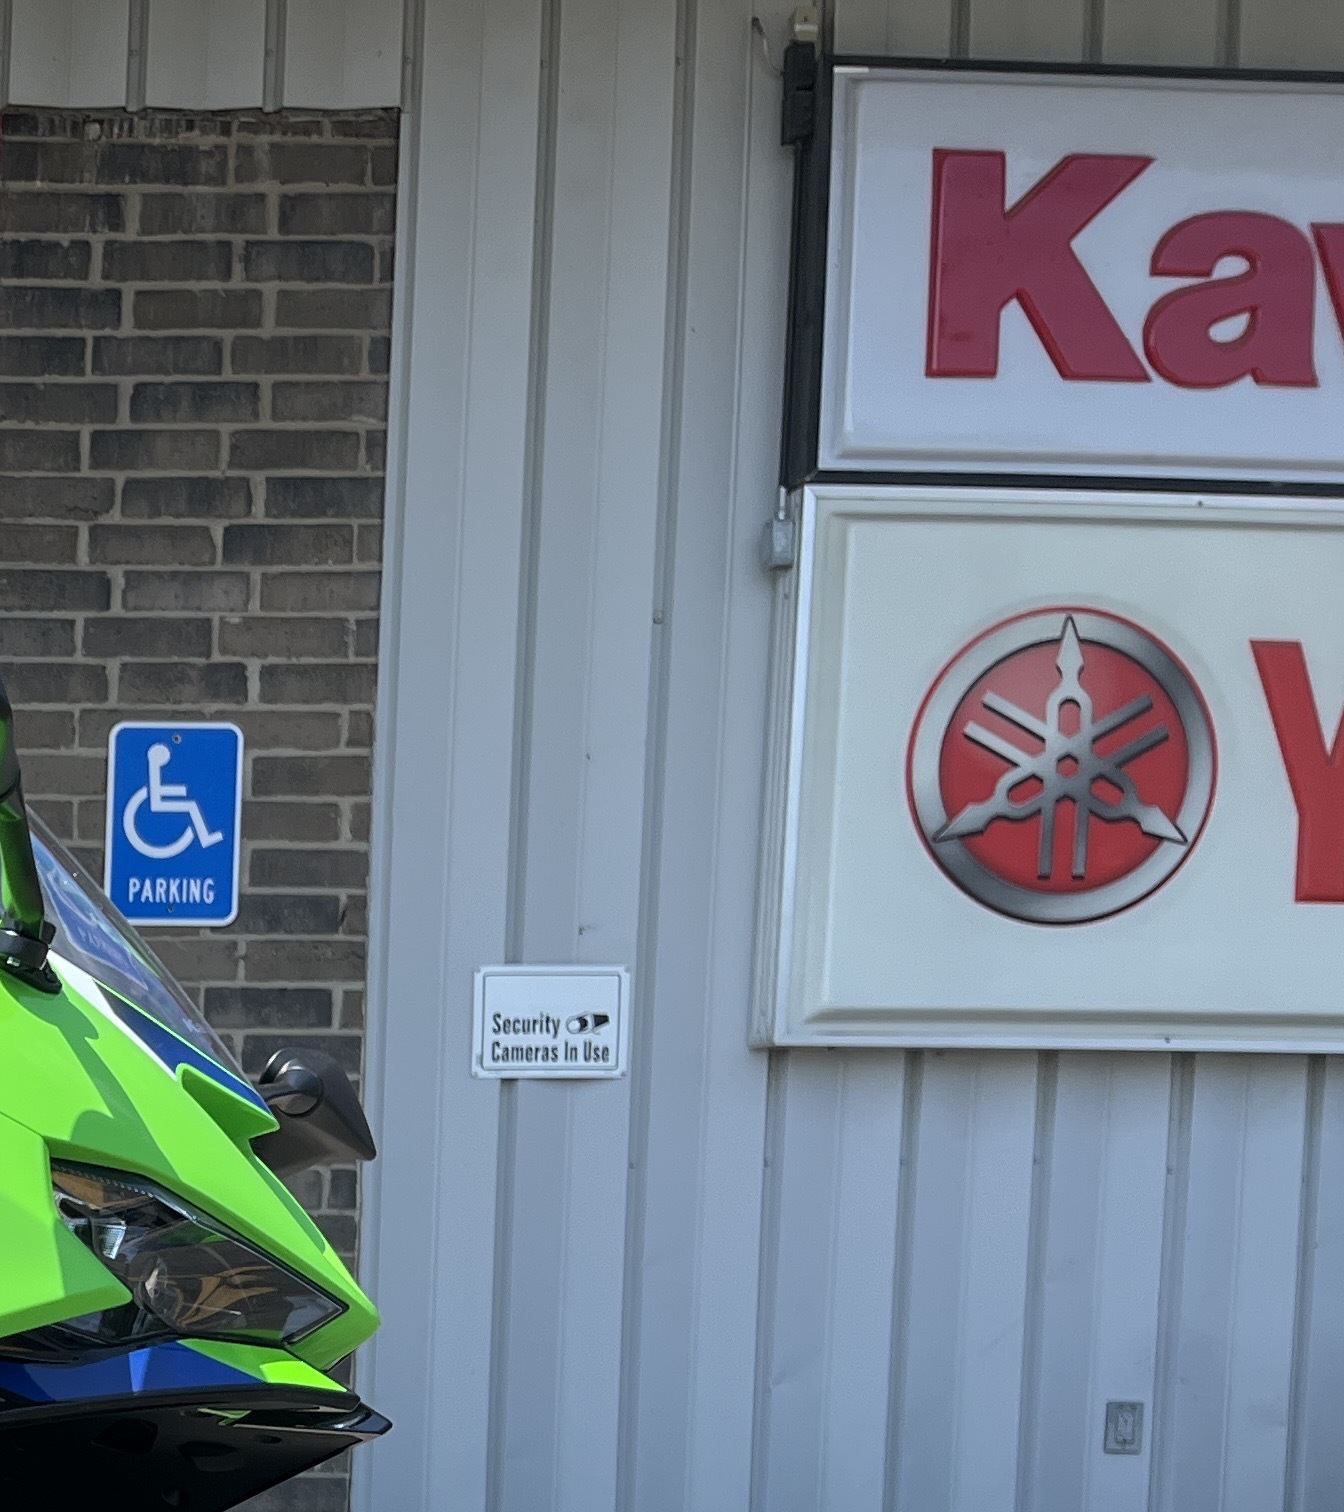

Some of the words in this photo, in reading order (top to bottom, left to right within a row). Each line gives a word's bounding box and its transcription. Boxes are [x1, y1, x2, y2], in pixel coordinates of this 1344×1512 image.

[925, 147, 1344, 389] Ka
[128, 877, 215, 904] PARKING
[492, 1012, 560, 1038] Security
[491, 1041, 558, 1062] Cameras
[564, 1041, 578, 1062] In
[584, 1041, 610, 1062] Use
